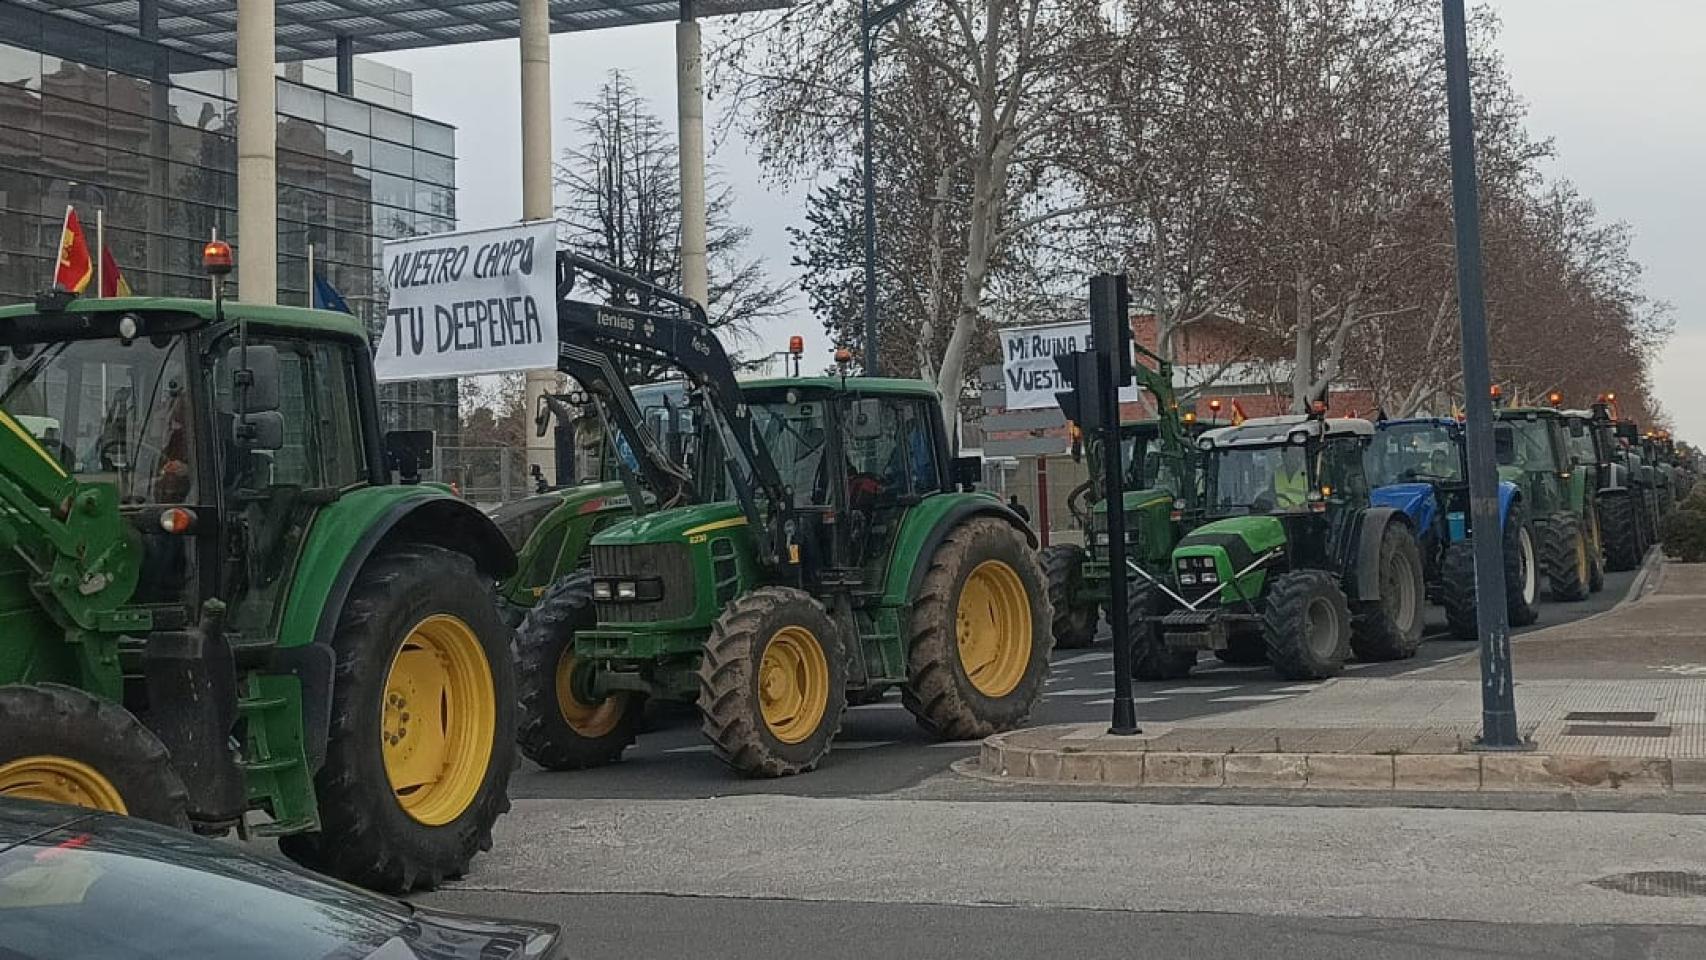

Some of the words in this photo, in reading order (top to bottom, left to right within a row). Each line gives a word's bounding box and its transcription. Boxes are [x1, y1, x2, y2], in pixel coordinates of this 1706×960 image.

[388, 246, 469, 289] NUESTRO
[473, 236, 535, 279] CAMPO
[387, 307, 425, 357] TU
[434, 296, 543, 353] DESPENSA
